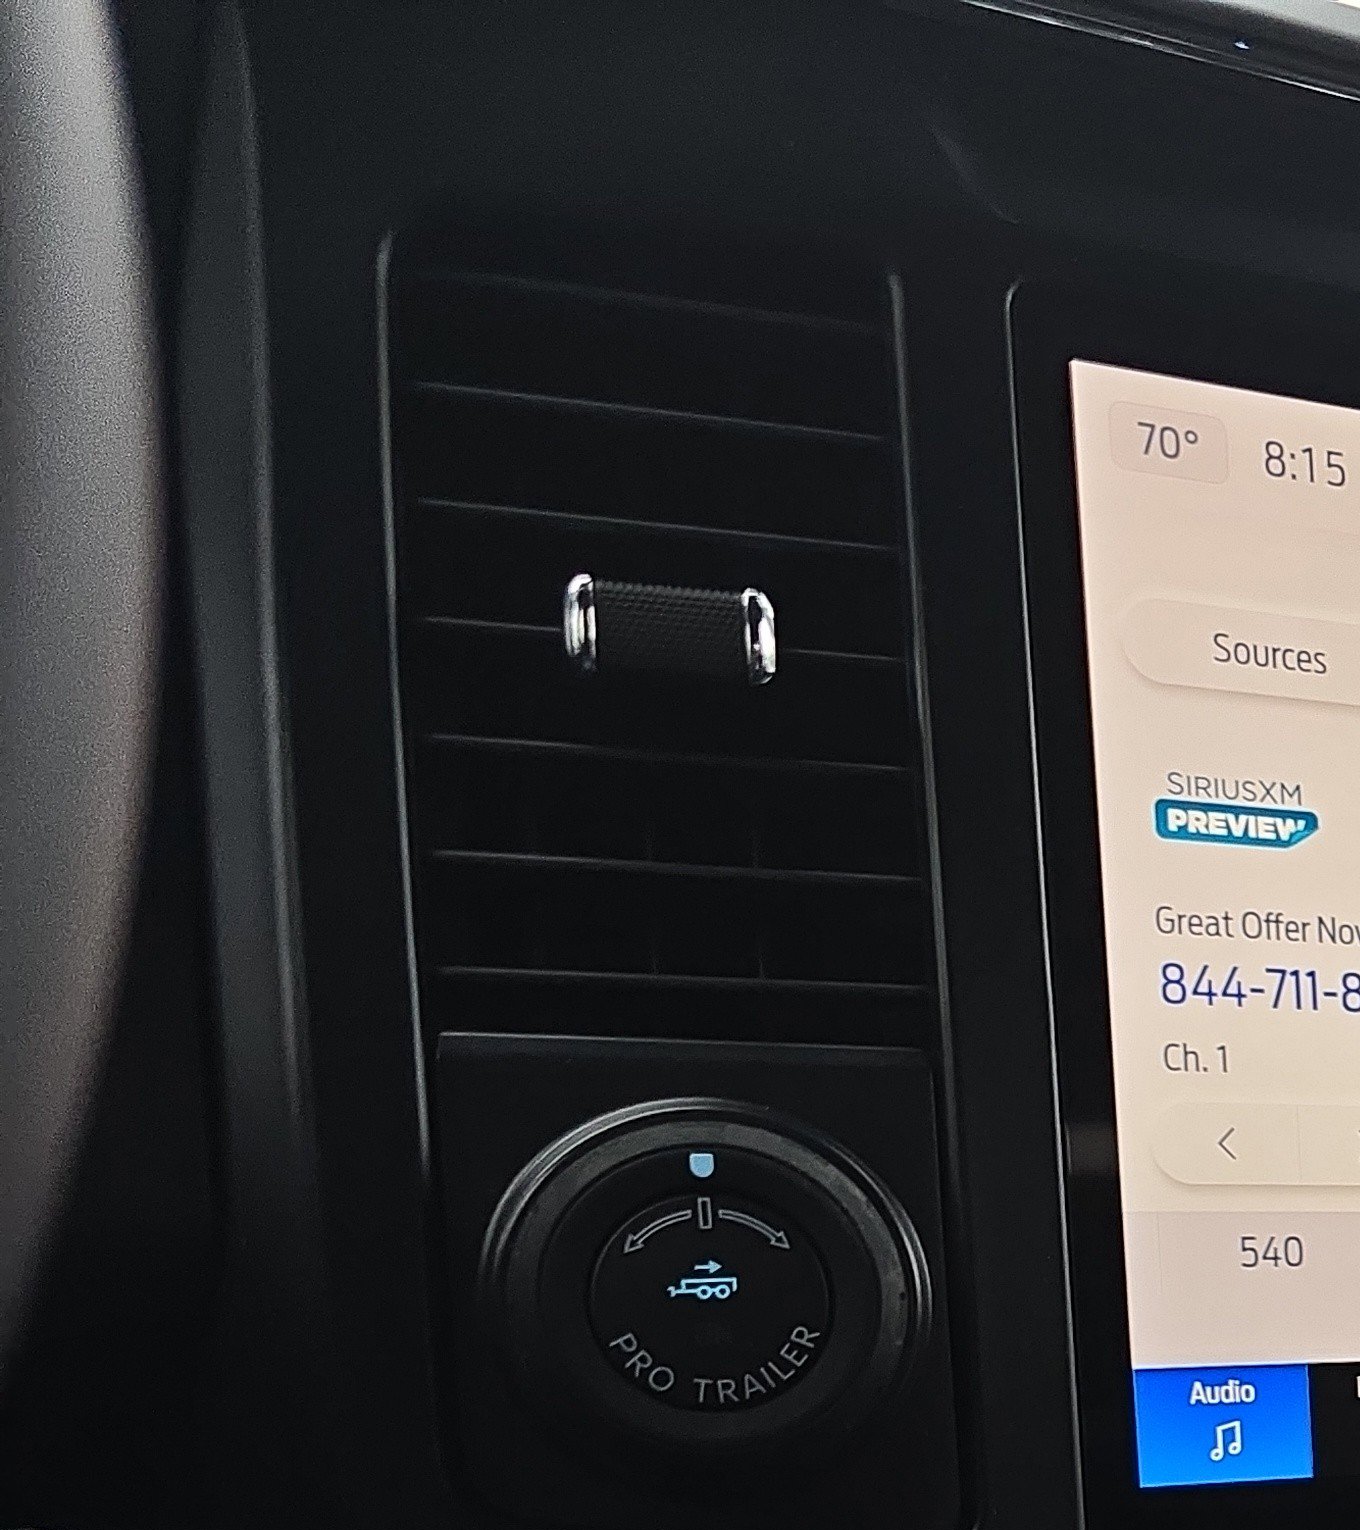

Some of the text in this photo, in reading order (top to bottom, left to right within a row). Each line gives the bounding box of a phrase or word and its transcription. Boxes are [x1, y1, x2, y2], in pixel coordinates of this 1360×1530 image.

[1137, 421, 1199, 460] 70°
[1264, 440, 1346, 487] 8:15
[1213, 632, 1327, 675] Sources
[1167, 772, 1302, 806] SIRIUSXM
[1166, 807, 1306, 841] PREVIEW
[1155, 905, 1235, 938] Great
[1241, 911, 1311, 943] Offer
[1163, 1042, 1228, 1073] Ch. 1
[1240, 1235, 1304, 1268] 540
[609, 1325, 820, 1404] PRO TRAILER
[1189, 1379, 1256, 1405] Audio
